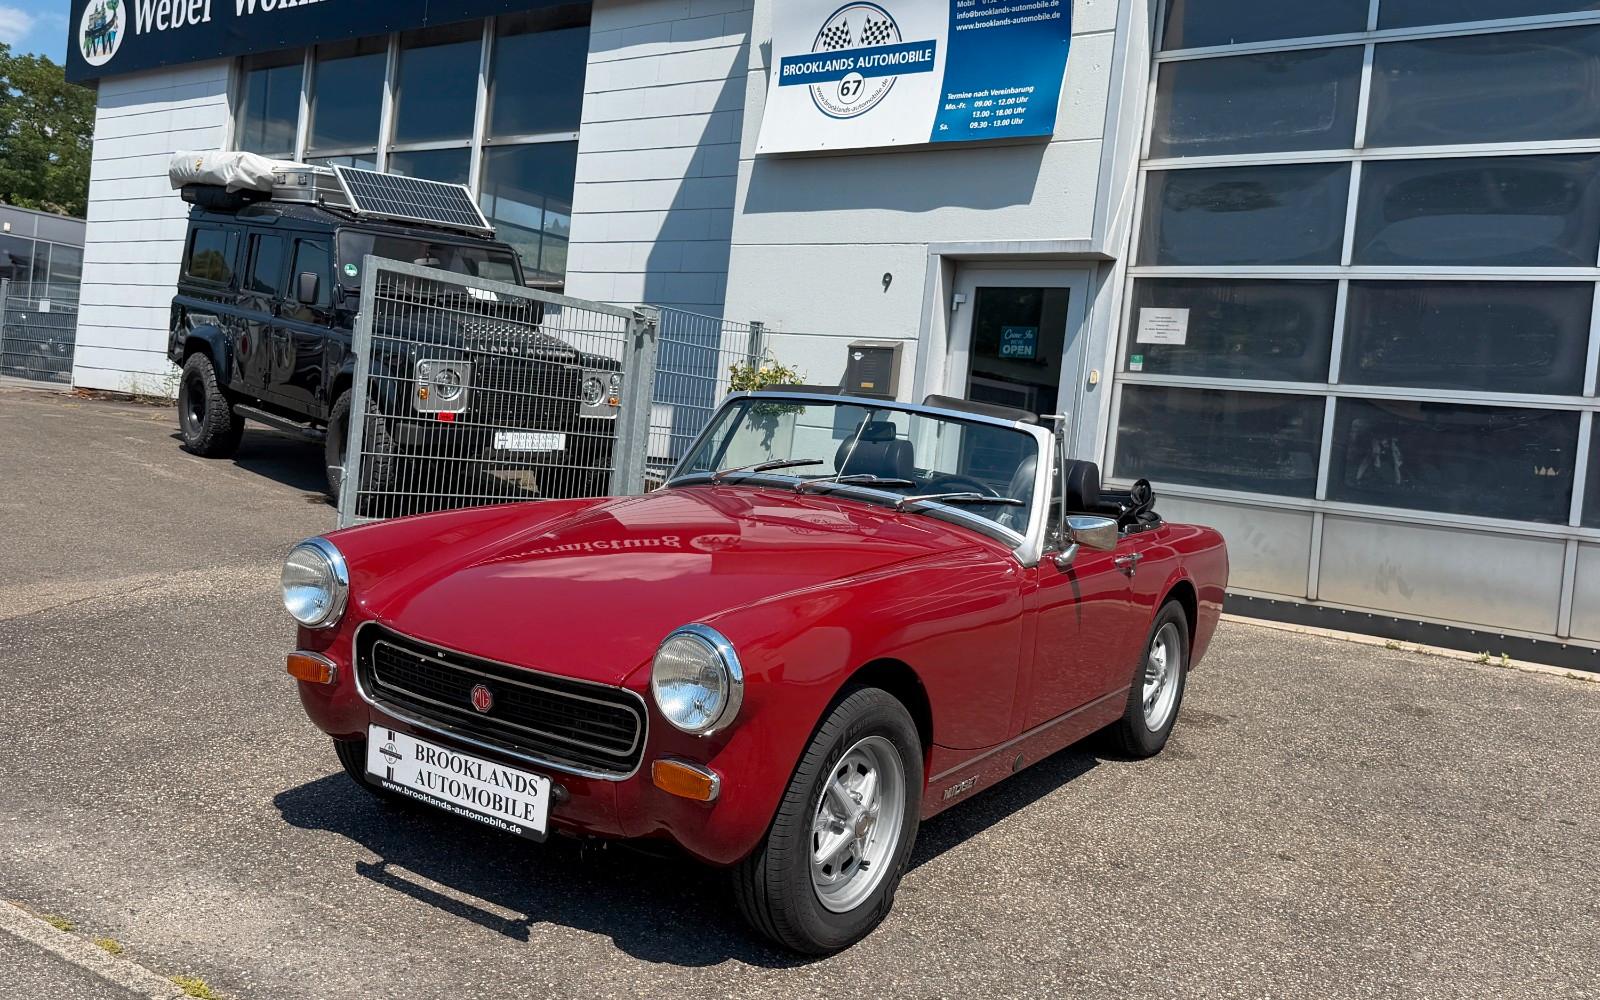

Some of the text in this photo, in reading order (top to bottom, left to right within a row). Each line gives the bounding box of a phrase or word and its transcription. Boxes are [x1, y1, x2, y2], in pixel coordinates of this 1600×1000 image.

[135, 0, 211, 35] Weber
[956, 0, 1060, 20] info@brooklands-automobile.de
[956, 12, 1060, 31] www.brooklands-automobile.de
[783, 48, 932, 76] BROOKLANDS AUTOMOBILE
[840, 80, 862, 97] 67
[947, 86, 1034, 100] Termine nach Vereinbarung
[974, 100, 992, 108] 09.00
[998, 98, 1015, 106] 12.00
[1016, 96, 1029, 104] Uhr
[996, 108, 1012, 116] 18.00
[882, 272, 893, 293] 9
[1003, 345, 1032, 355] OPEN
[473, 687, 491, 711] MG
[415, 743, 538, 797] BROOKLANDS
[414, 768, 535, 822] AUTOMOBILE
[382, 780, 522, 834] www.brooklands-automobile.de
